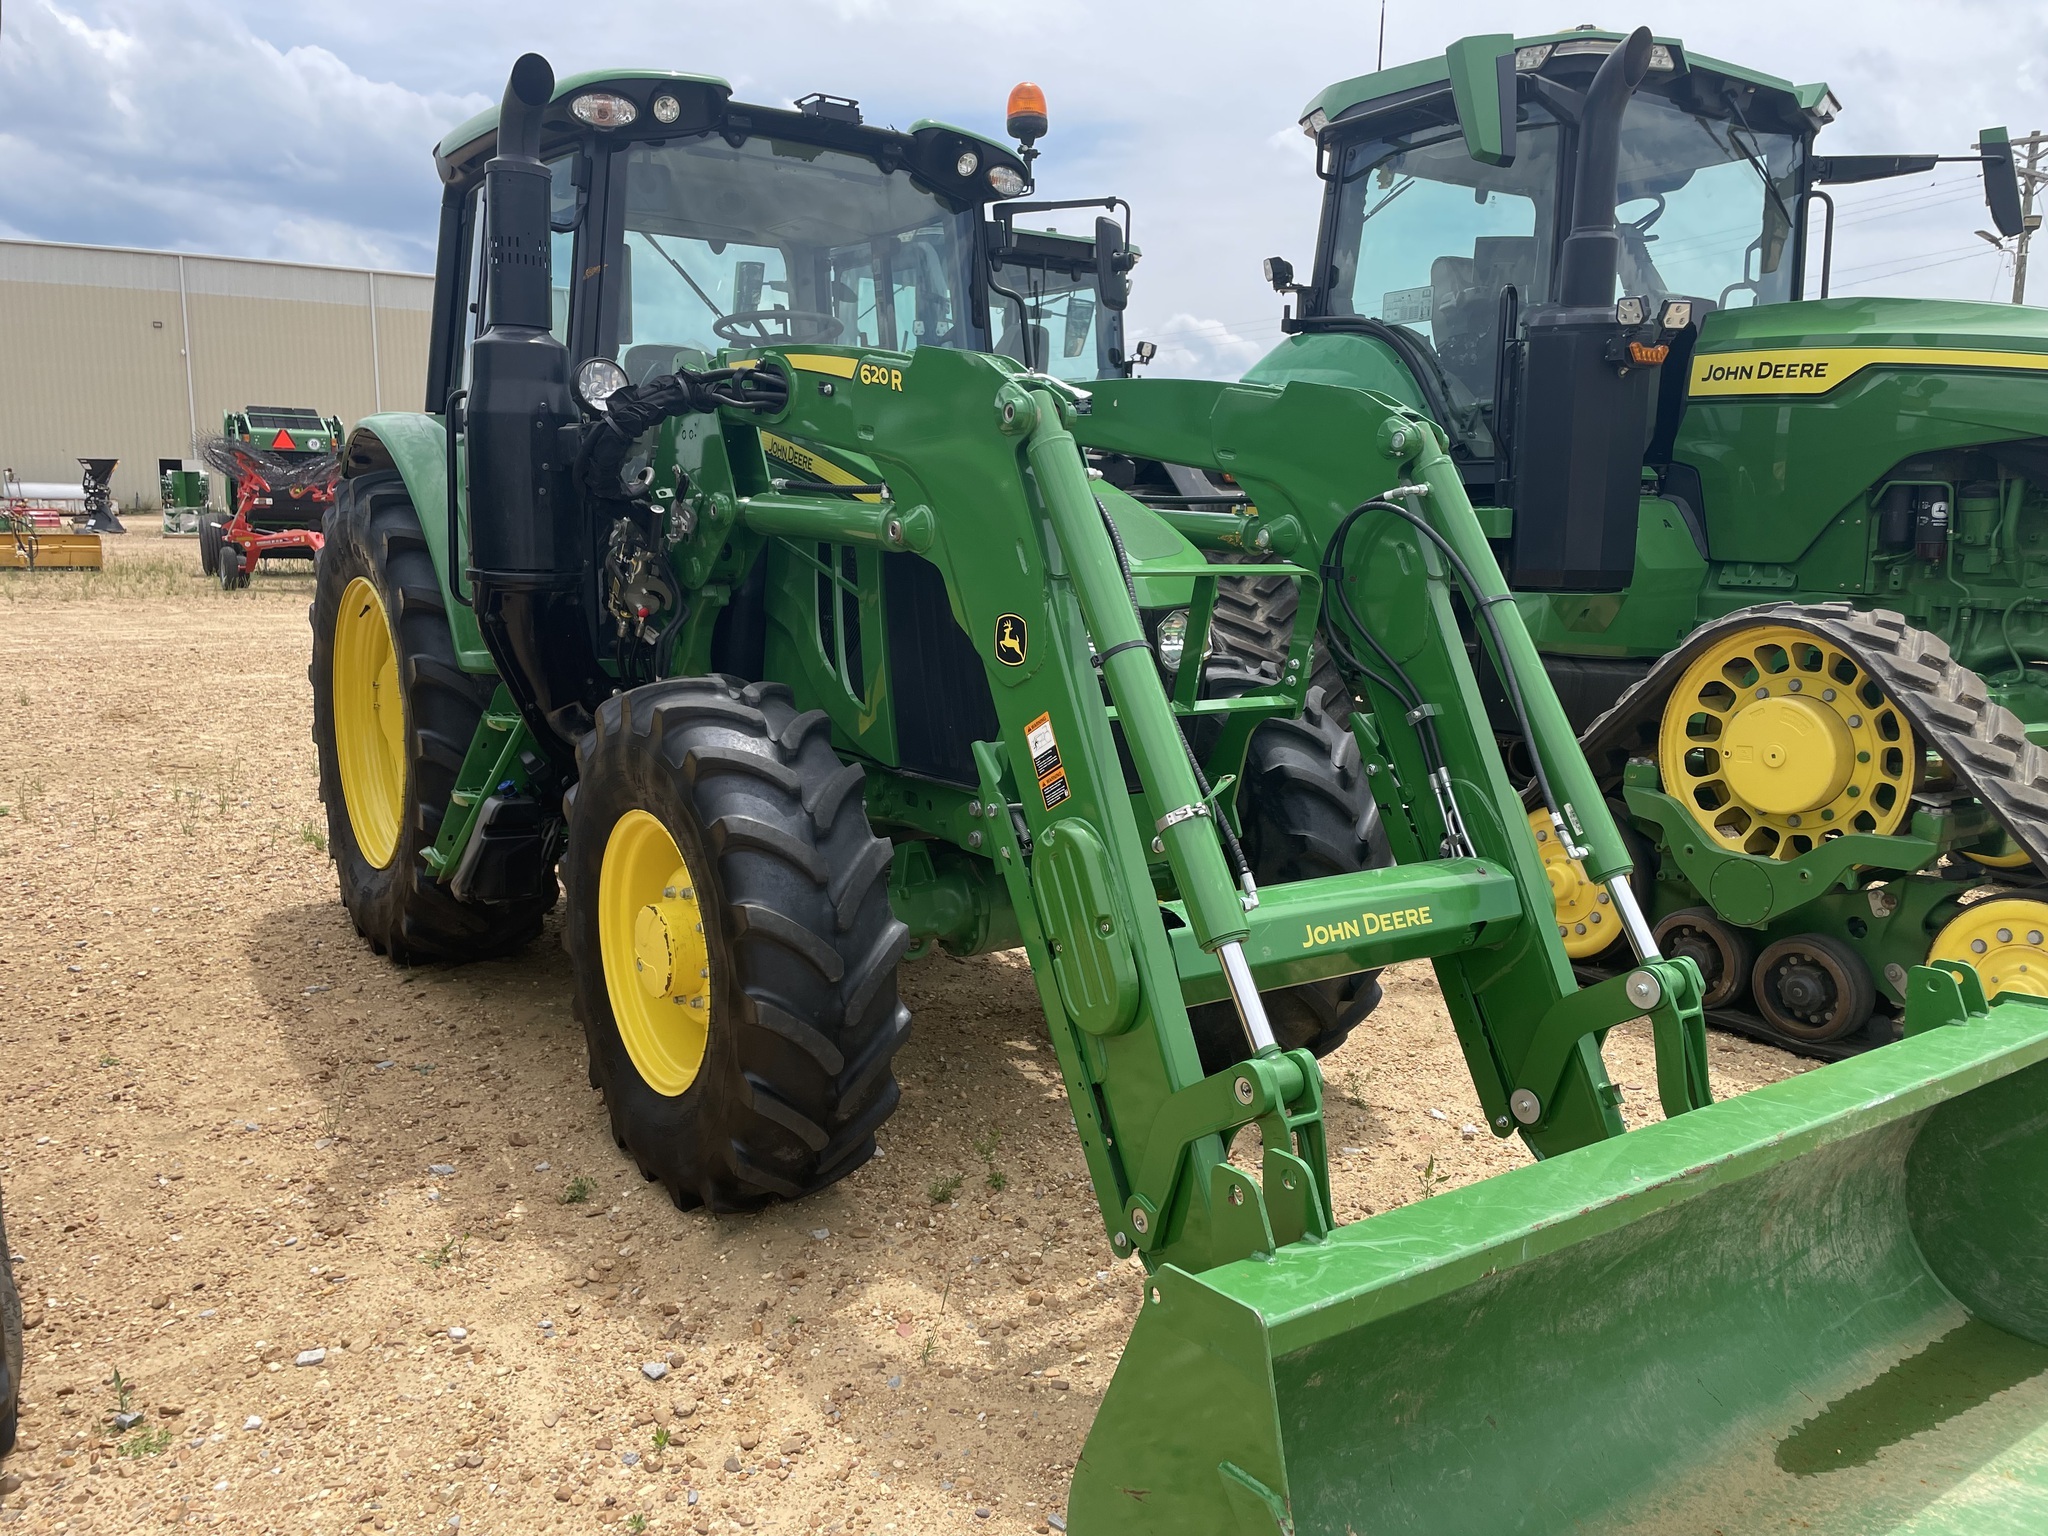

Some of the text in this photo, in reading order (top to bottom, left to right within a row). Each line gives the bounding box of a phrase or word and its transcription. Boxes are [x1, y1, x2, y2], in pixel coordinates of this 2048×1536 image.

[860, 363, 903, 392] 620 R
[1701, 361, 1829, 382] JOHN DEERE
[769, 437, 813, 471] JOHN DEERE
[1302, 906, 1433, 948] JOHN DEERE
